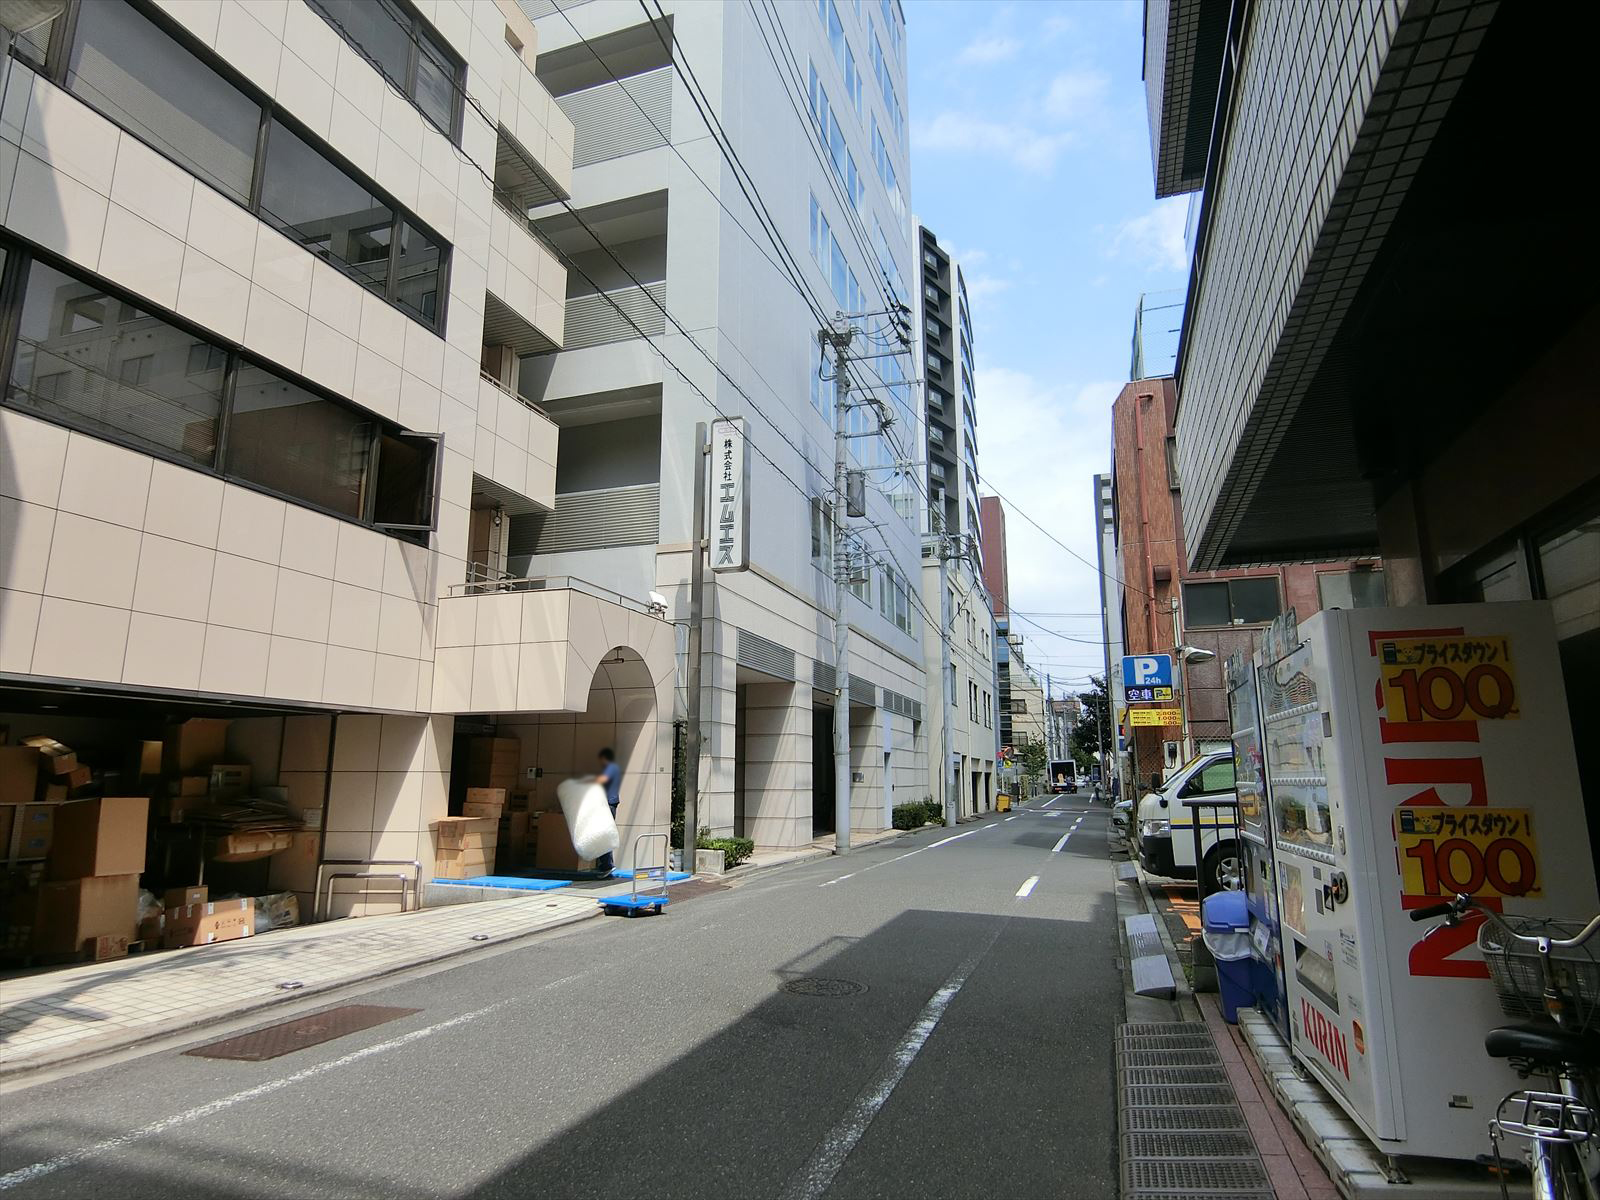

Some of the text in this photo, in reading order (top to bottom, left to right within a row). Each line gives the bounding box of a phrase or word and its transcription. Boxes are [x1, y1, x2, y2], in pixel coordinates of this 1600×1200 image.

[1134, 658, 1159, 685] P
[1145, 677, 1162, 685] 24h
[1128, 688, 1152, 700] 空車
[1300, 997, 1351, 1082] KIRIN
